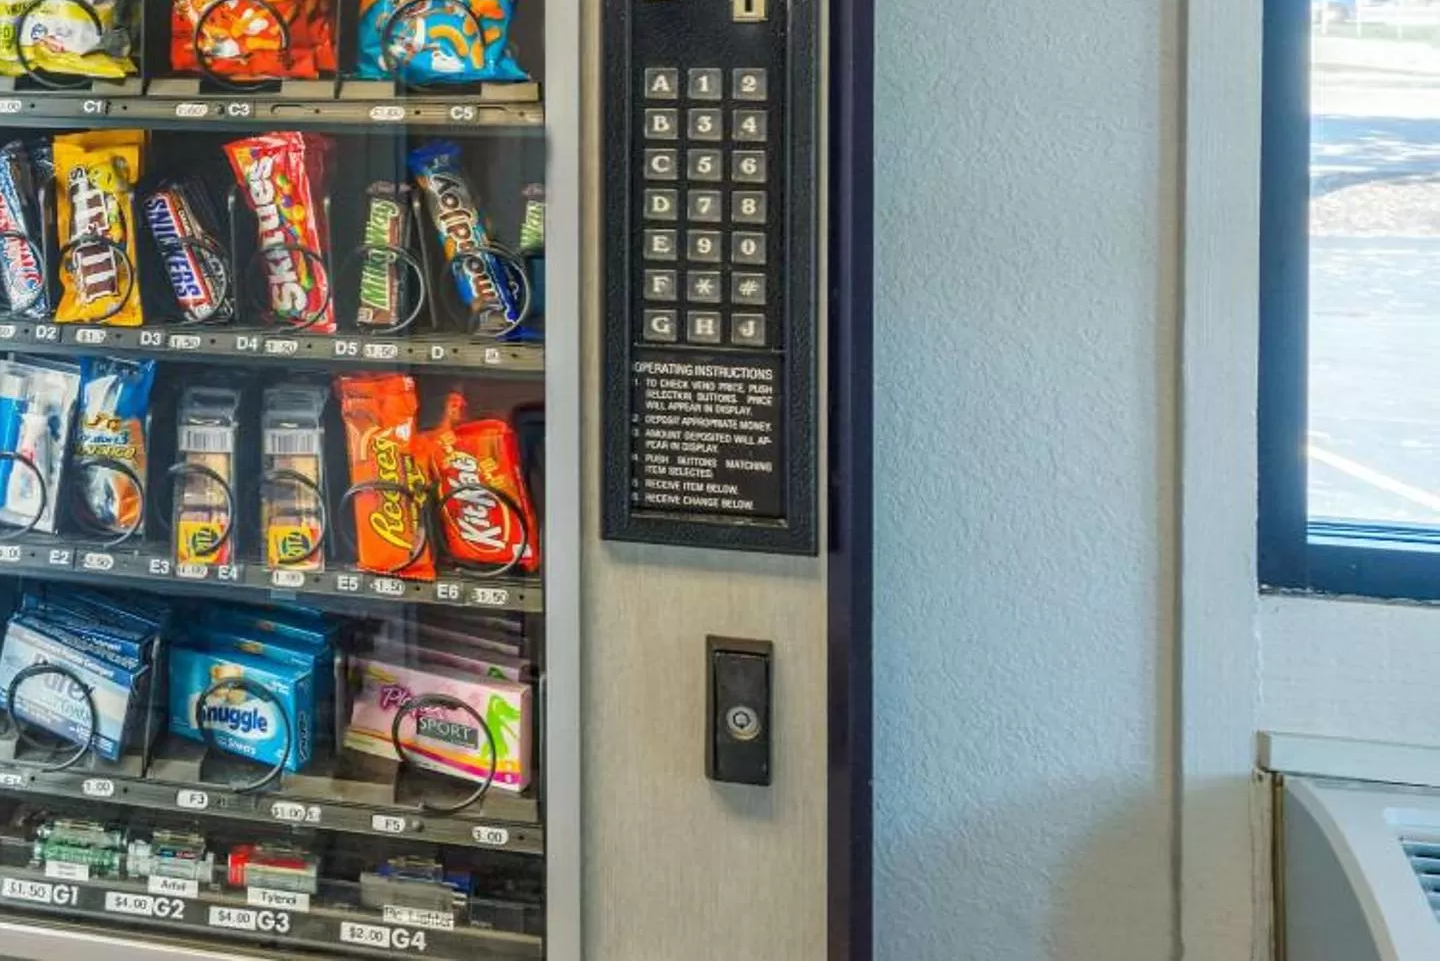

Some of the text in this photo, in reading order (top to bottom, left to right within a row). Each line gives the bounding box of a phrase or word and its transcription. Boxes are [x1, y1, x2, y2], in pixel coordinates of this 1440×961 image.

[652, 75, 670, 92] A
[698, 76, 709, 92] 1
[741, 75, 756, 92] 2
[84, 100, 102, 113] C1
[228, 104, 249, 116] C3
[451, 106, 472, 119] C5
[653, 115, 670, 132] B
[697, 115, 712, 132] 3
[741, 117, 757, 133] 4
[652, 155, 671, 172] C
[697, 156, 712, 173] 5
[741, 158, 756, 174] 6
[652, 196, 670, 213] D
[697, 197, 712, 213] 7
[741, 198, 756, 214] 8
[652, 236, 670, 253] E
[697, 237, 712, 254] 9
[652, 276, 669, 292] F
[36, 326, 56, 338] D2
[651, 316, 671, 334] G
[695, 318, 714, 336] H
[741, 320, 755, 337] J
[141, 332, 161, 345] D3
[237, 338, 257, 350] D4
[336, 342, 357, 354] D5
[634, 362, 773, 380] OPERATING INSTRUCTIONS
[50, 551, 69, 564] E2
[150, 560, 169, 573] E3
[218, 566, 238, 579] E4
[338, 577, 358, 590] E5
[437, 585, 458, 599] E6
[420, 718, 472, 739] SPORT
[189, 793, 204, 805] F3
[385, 819, 400, 831] F5
[53, 885, 78, 905] G1
[115, 896, 185, 919] $4.00 G2
[218, 911, 290, 932] $4.00 G3
[391, 929, 426, 950] G4
